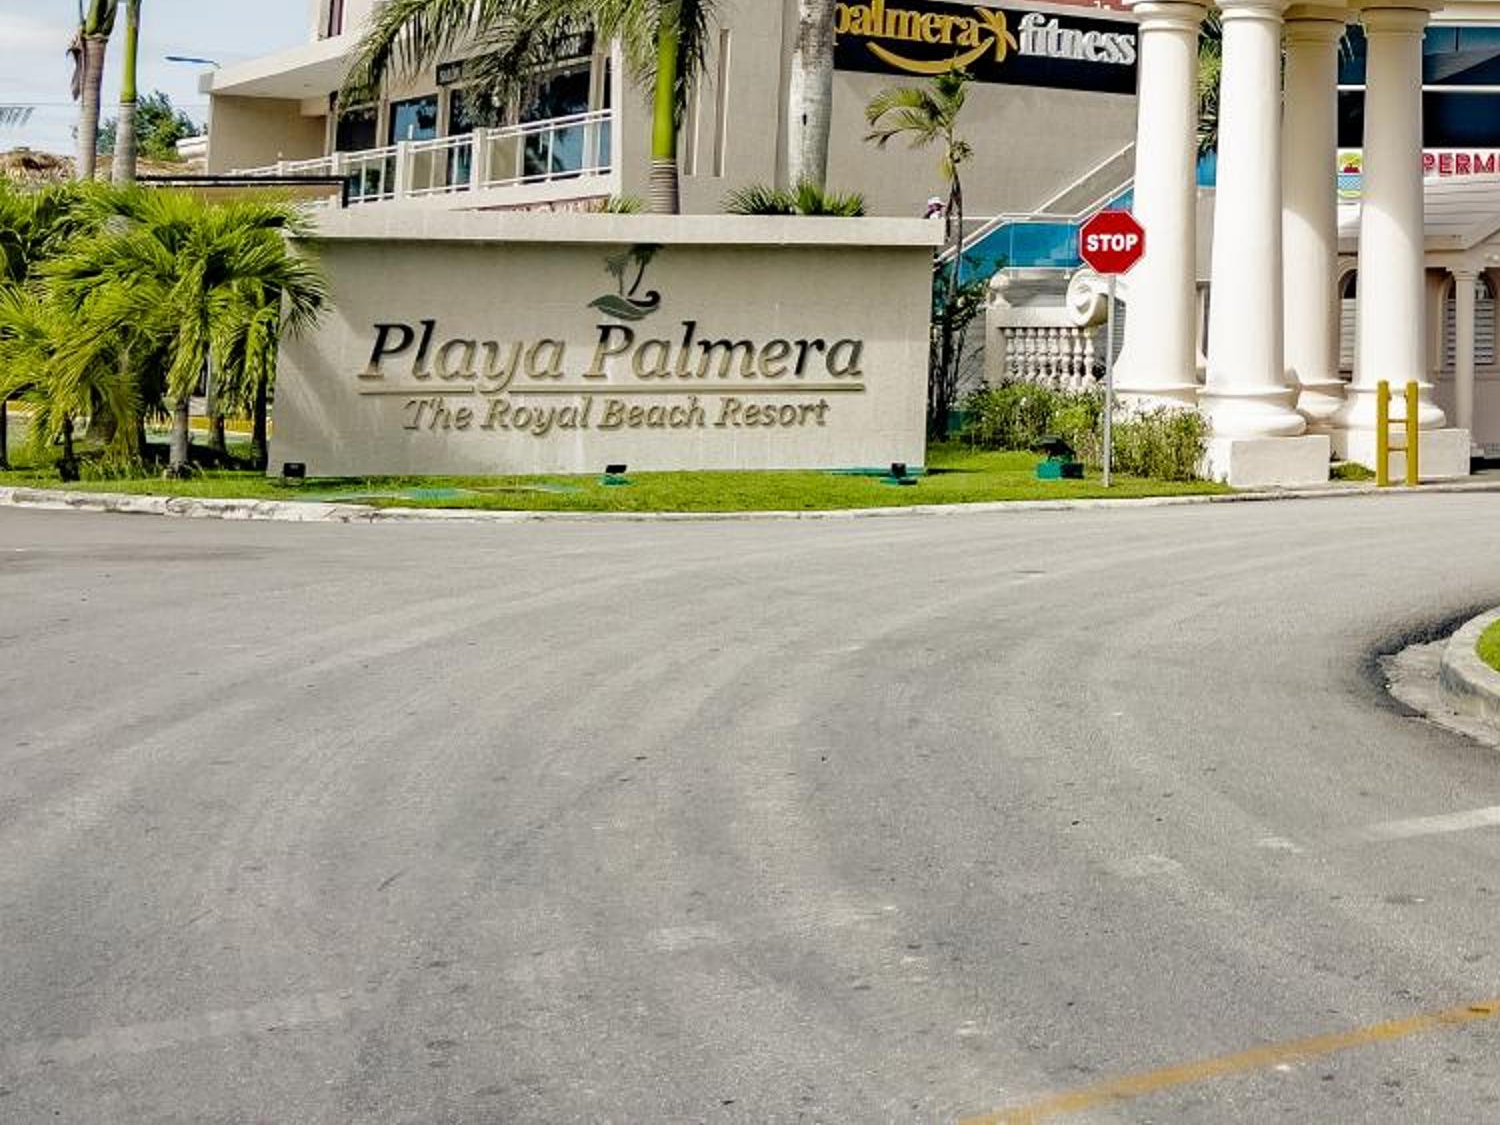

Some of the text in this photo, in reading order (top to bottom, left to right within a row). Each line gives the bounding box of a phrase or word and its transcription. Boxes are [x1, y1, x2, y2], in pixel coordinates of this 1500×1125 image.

[1018, 12, 1137, 65] fitness
[1086, 232, 1139, 252] STOP
[357, 319, 865, 393] Playa Palmera
[401, 394, 831, 436] The Royal Beach Resort
